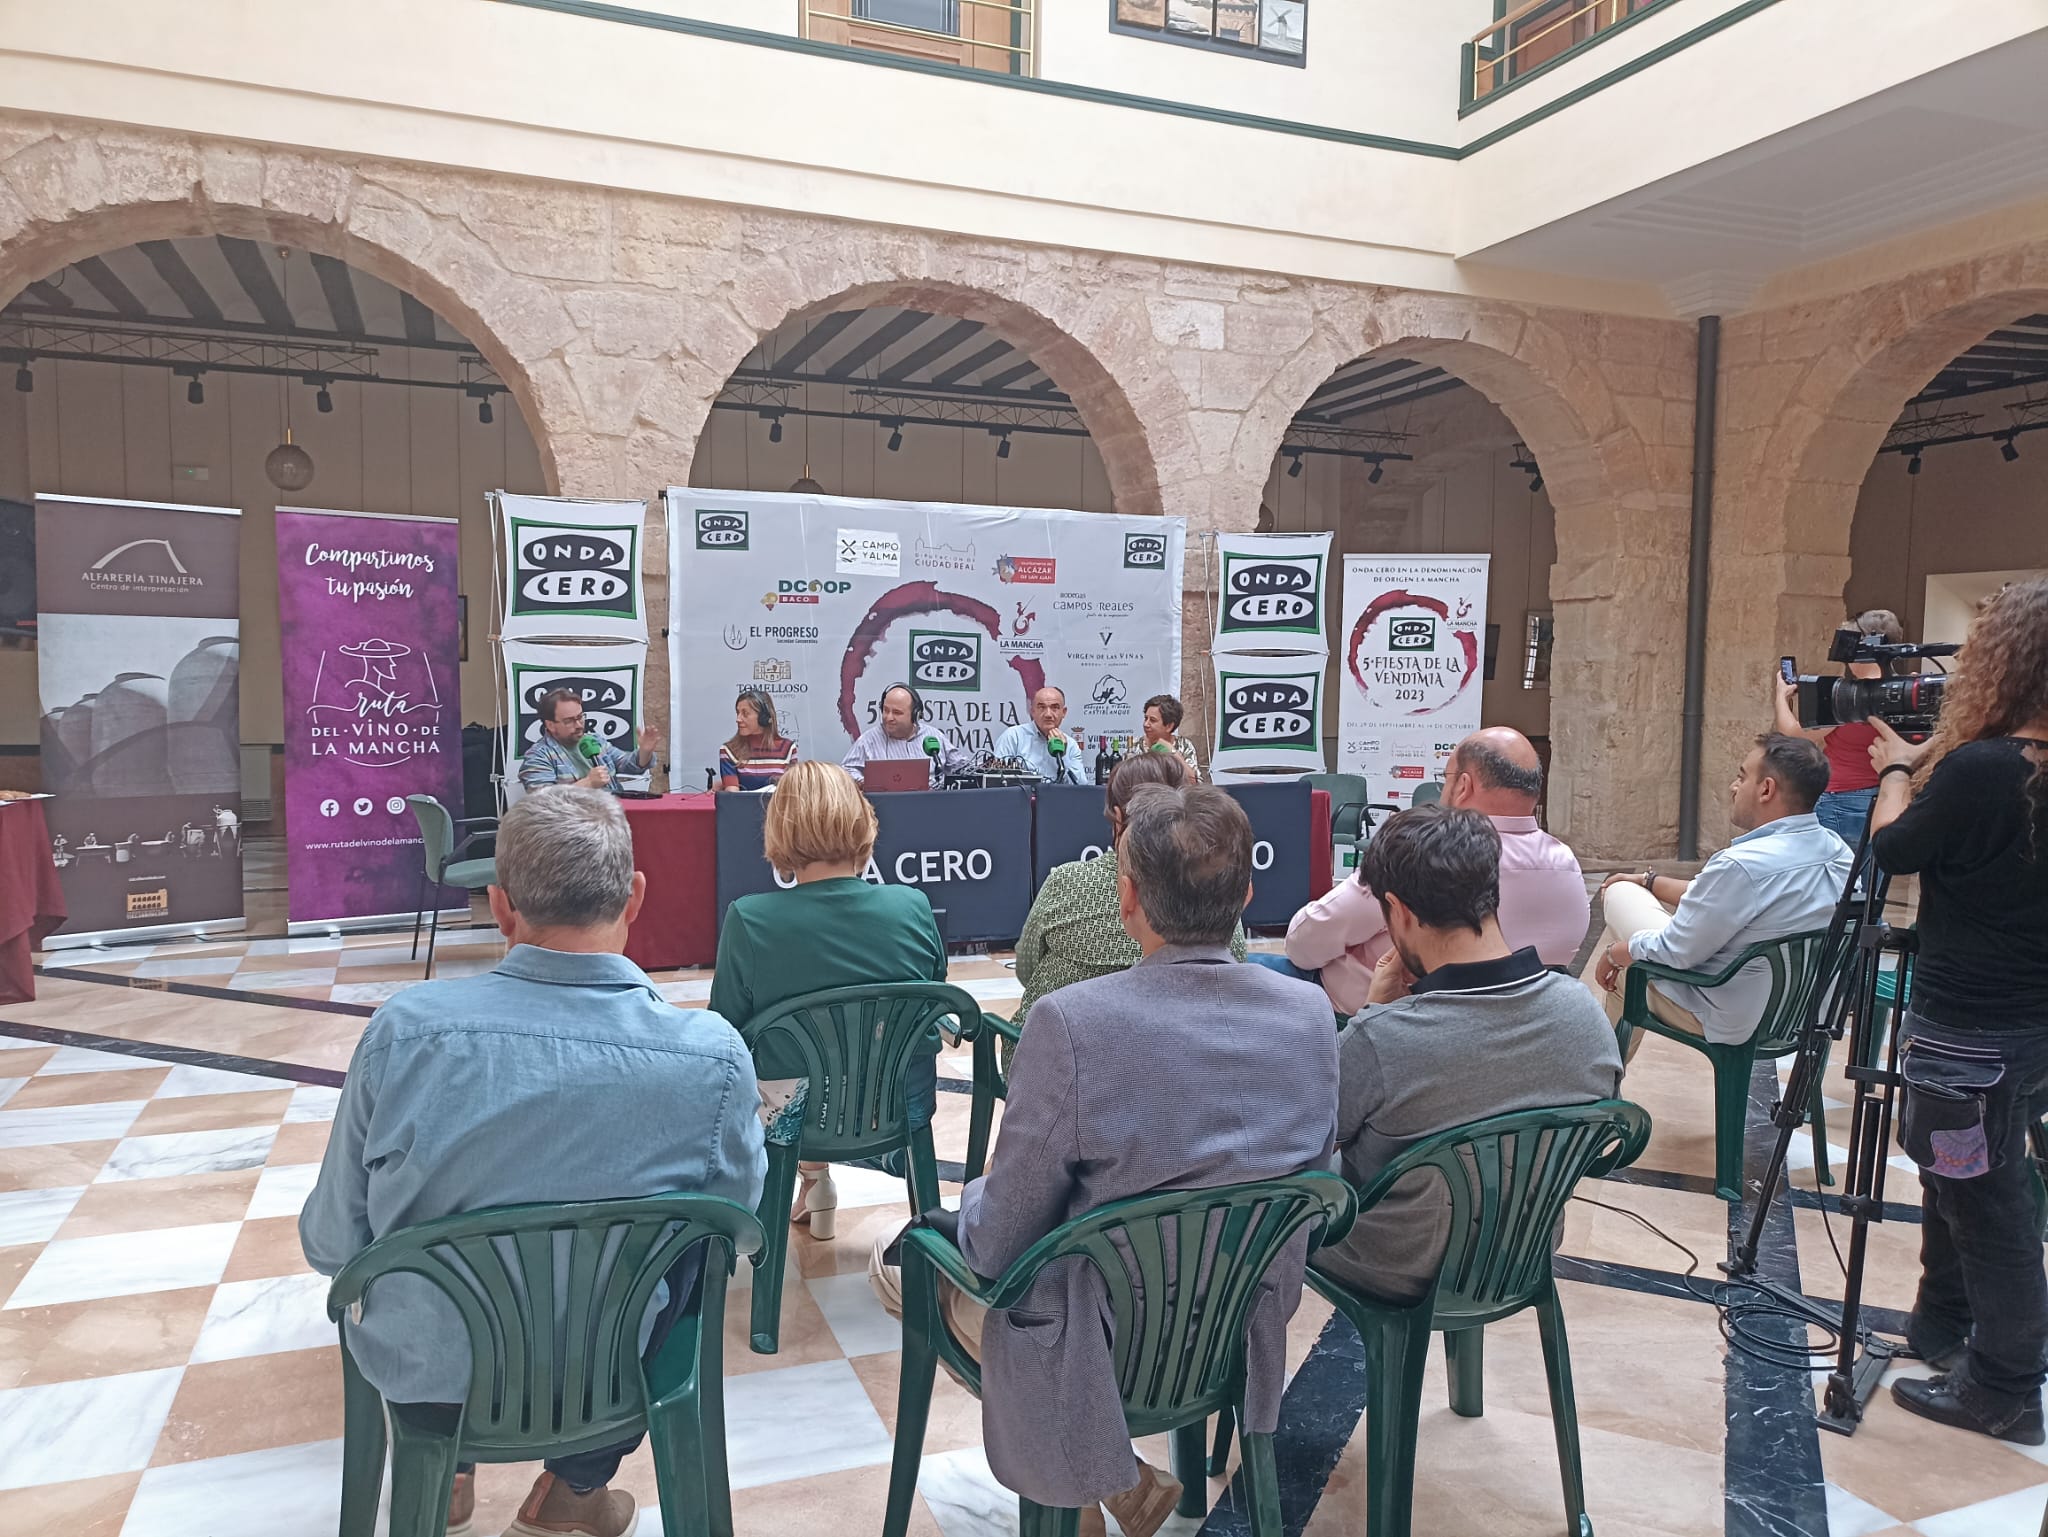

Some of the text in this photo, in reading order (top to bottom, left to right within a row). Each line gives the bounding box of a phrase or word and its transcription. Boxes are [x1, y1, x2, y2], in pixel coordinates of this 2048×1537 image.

[704, 519, 740, 528] ONDA
[707, 533, 740, 542] CERO
[532, 543, 615, 561] ONDA
[862, 540, 899, 551] CAMPO
[305, 543, 435, 573] Compartimos
[1132, 553, 1159, 562] CERO
[914, 559, 976, 571] CIUDAD REAL
[90, 582, 118, 590] Centro
[148, 575, 204, 586] TINAJERA
[537, 576, 615, 596] CERO
[1239, 572, 1304, 587] ONDA
[324, 576, 414, 603] tu pasión
[1241, 600, 1303, 616] CERO
[750, 627, 819, 639] EL PROGRESO
[1011, 641, 1044, 649] MANCHA
[1398, 637, 1428, 645] CERO
[922, 645, 968, 657] ONDA
[1375, 656, 1421, 672] FIESTA
[1424, 657, 1441, 670] DE
[1446, 657, 1461, 673] LA
[924, 666, 968, 678] CERO
[1375, 669, 1444, 688] VENDIMIA
[736, 683, 808, 694] TOMELLOSO
[1236, 691, 1302, 705] ONDA
[1395, 689, 1425, 702] 2023
[357, 690, 408, 718] ruta
[965, 702, 992, 722] DE
[999, 701, 1020, 726] LA
[311, 727, 341, 737] DEL
[421, 726, 440, 735] DE
[1239, 718, 1301, 734] CERO
[312, 740, 440, 755] LA MANCHA
[895, 849, 993, 884] CERO
